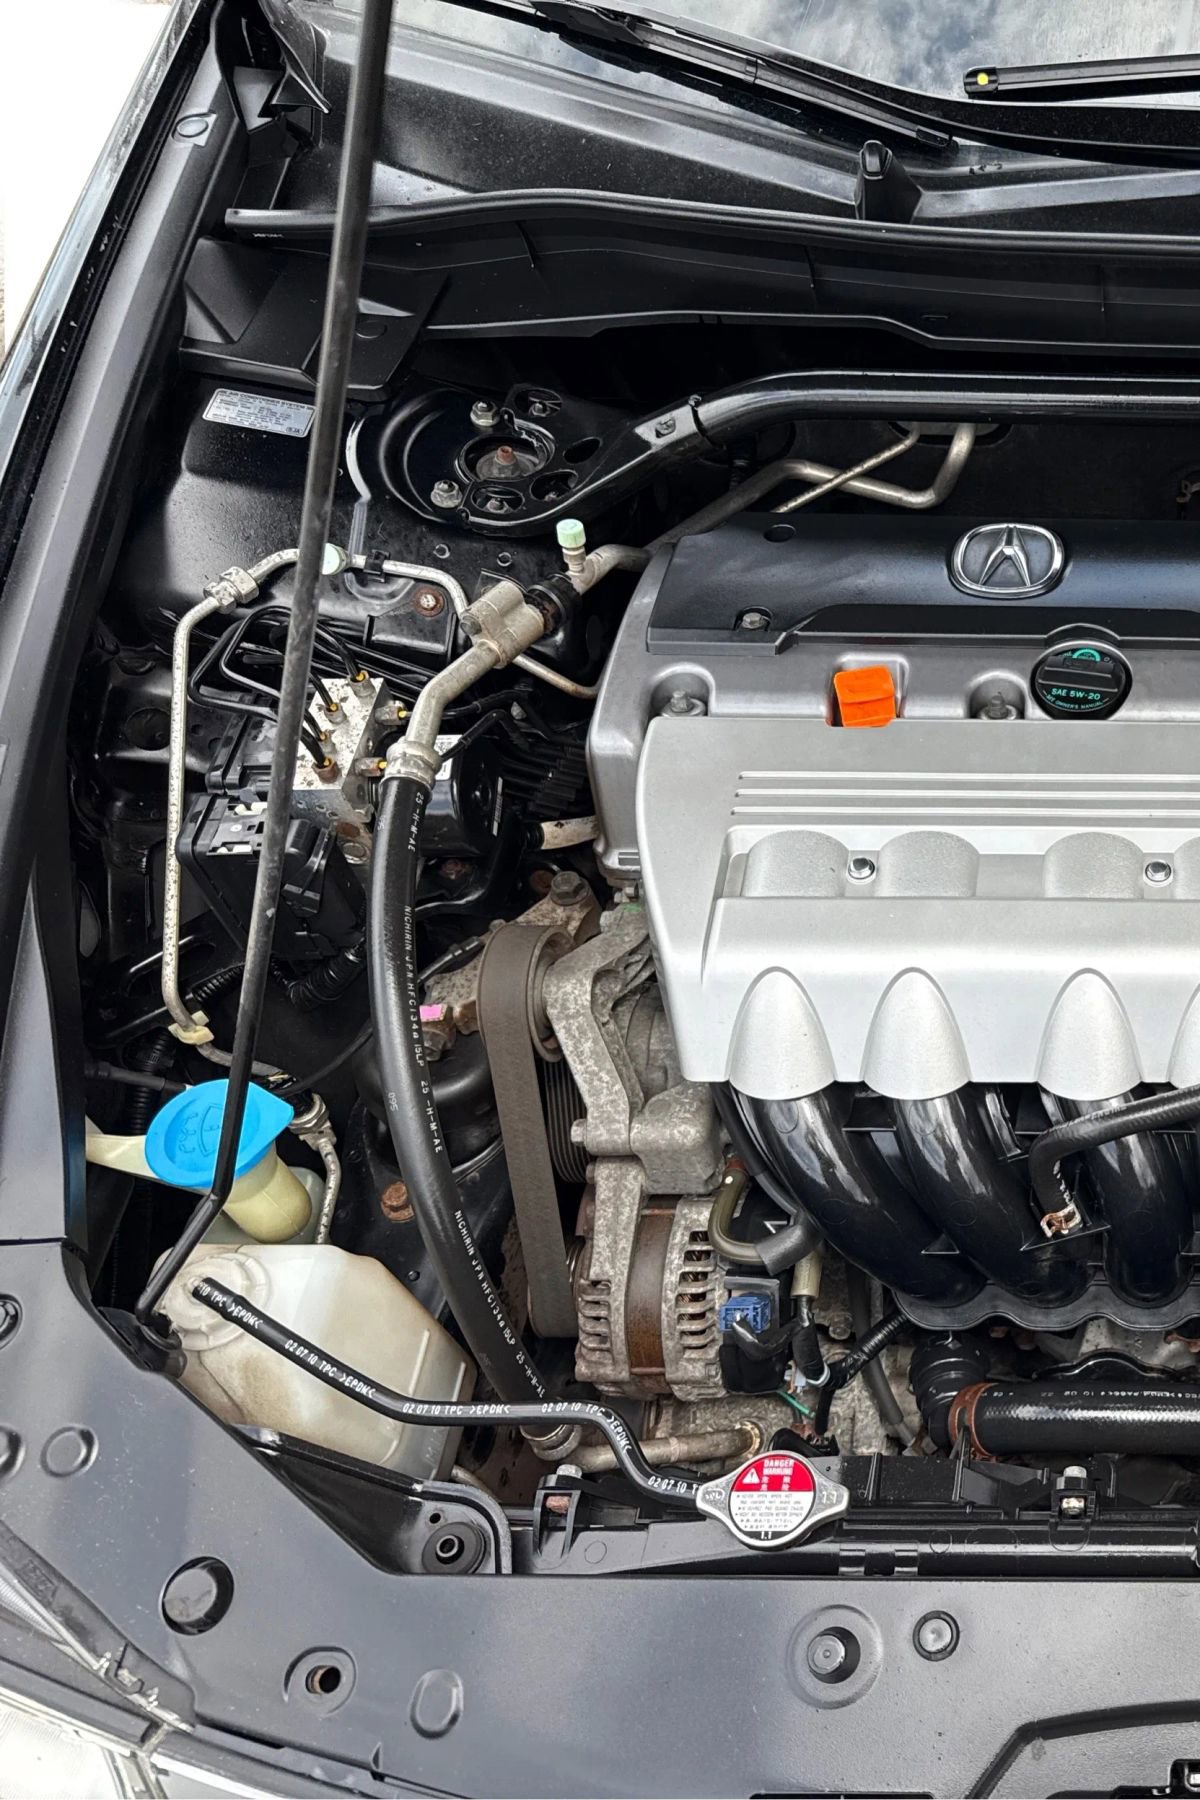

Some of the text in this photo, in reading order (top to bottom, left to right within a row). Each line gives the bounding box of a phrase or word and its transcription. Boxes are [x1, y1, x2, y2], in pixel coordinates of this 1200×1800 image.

[1051, 688, 1068, 696] SAE
[404, 906, 413, 951] NICHIRIN
[405, 956, 413, 983] JPN
[454, 1210, 476, 1256] NICHIRIN
[471, 1258, 484, 1281] JPN
[210, 1289, 227, 1308] TPC
[285, 1339, 297, 1354] 02
[297, 1346, 307, 1357] 07
[308, 1352, 318, 1365] 10
[319, 1360, 338, 1377] TPC
[403, 1403, 416, 1414] 02
[416, 1404, 428, 1415] 07
[430, 1404, 441, 1415] 10
[444, 1405, 463, 1415] TPC
[542, 1403, 554, 1413] 02
[571, 1402, 582, 1411] 10
[585, 1403, 606, 1417] TPC
[764, 1459, 795, 1467] DANGER
[648, 1475, 661, 1488] 02
[661, 1478, 675, 1491] 07
[675, 1480, 687, 1493] 10
[761, 1531, 772, 1540] 1.1
